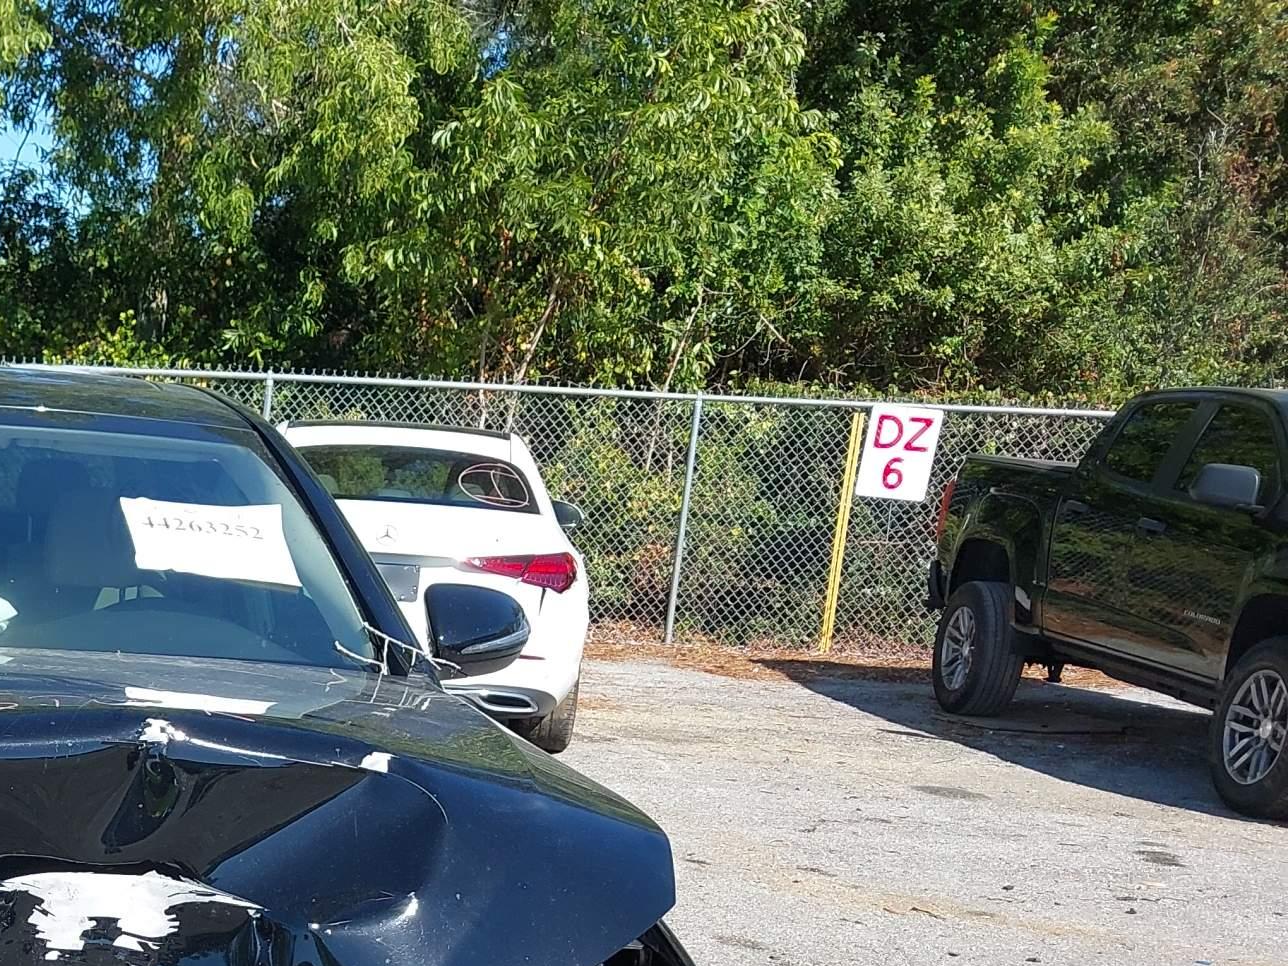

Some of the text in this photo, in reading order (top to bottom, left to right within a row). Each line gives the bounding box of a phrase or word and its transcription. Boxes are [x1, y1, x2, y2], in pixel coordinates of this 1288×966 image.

[874, 415, 934, 452] DZ
[883, 457, 904, 489] 6
[142, 516, 264, 540] 44263252
